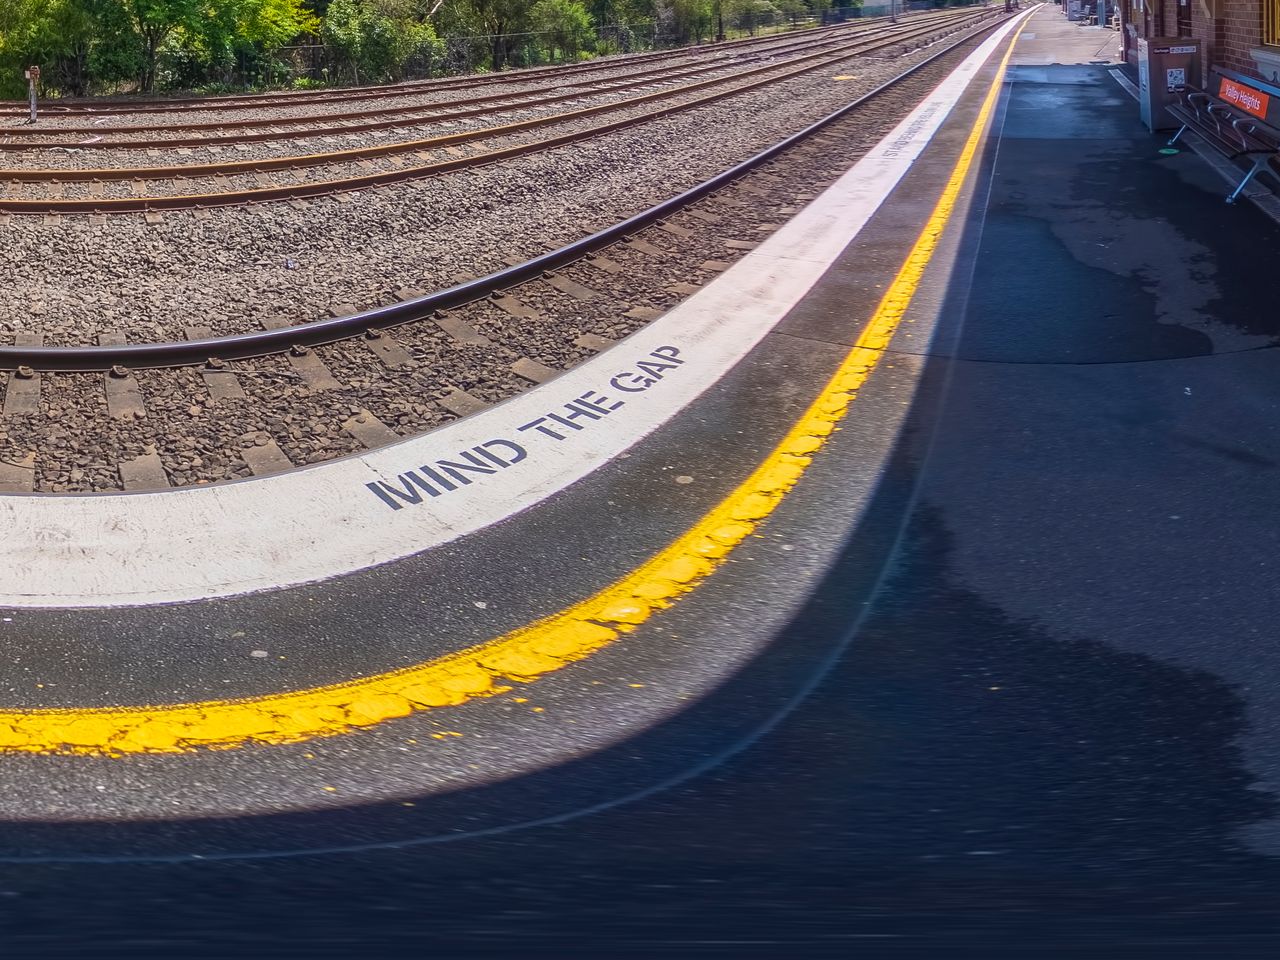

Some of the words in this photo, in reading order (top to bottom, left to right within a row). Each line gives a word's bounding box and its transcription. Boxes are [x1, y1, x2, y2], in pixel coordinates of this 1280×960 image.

[1226, 84, 1240, 103] Valley
[1239, 91, 1261, 111] Heights
[365, 439, 528, 511] MIND
[517, 390, 625, 441] THE
[609, 344, 687, 393] GAP
